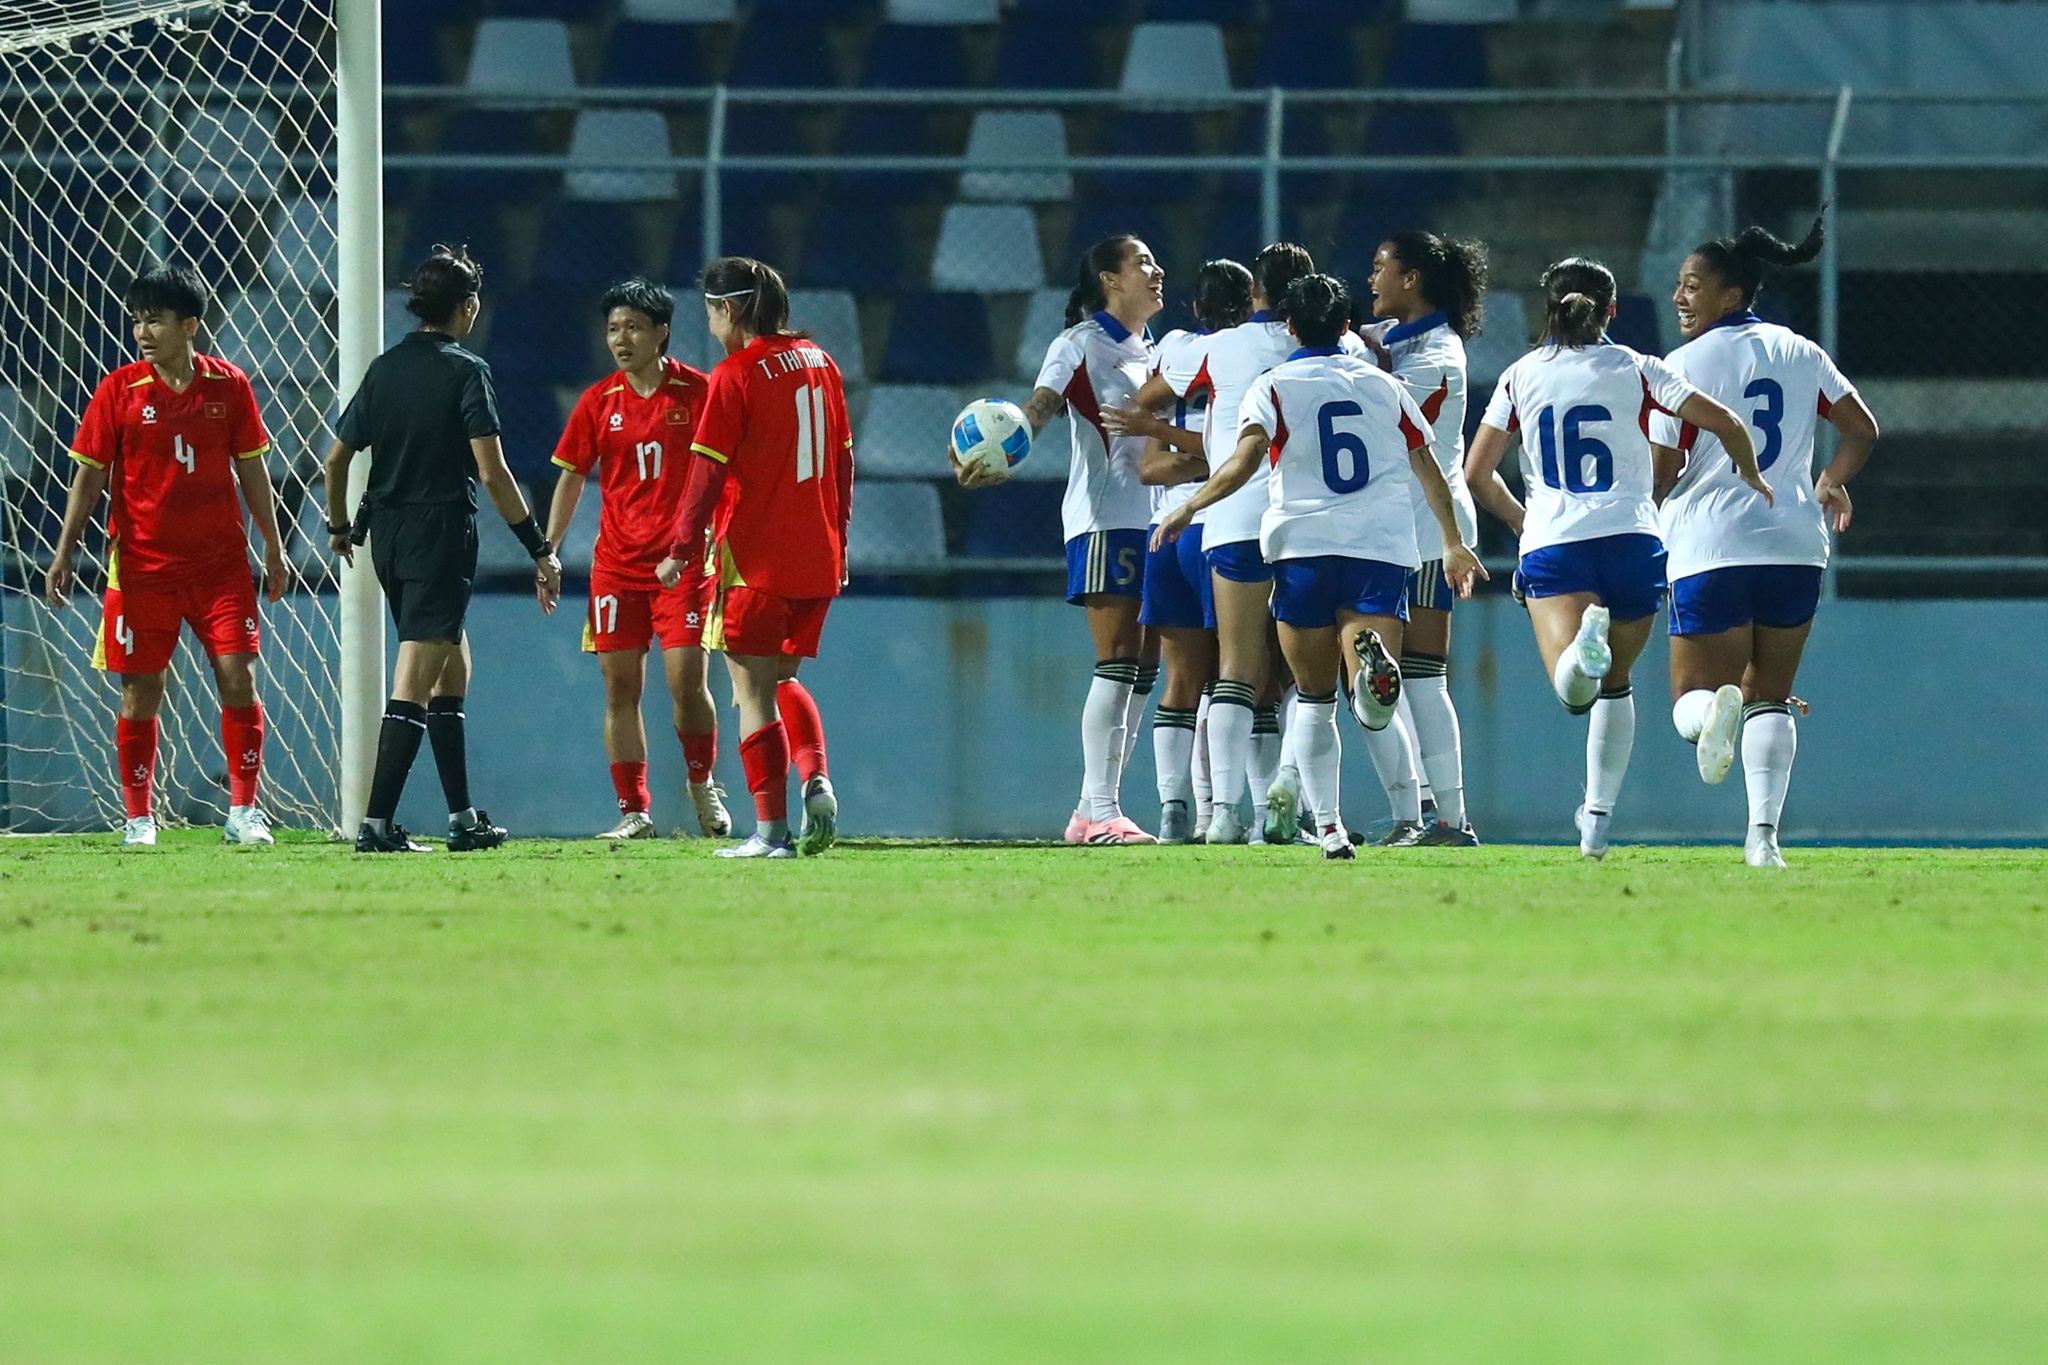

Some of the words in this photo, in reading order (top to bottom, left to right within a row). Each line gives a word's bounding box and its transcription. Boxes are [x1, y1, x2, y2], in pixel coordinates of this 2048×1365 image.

[773, 349, 804, 373] THI
[174, 433, 195, 474] 4
[795, 383, 826, 484] 11
[1317, 400, 1370, 494] 6
[1538, 404, 1614, 494] 16
[635, 440, 663, 481] 17
[115, 614, 134, 656] 4
[594, 594, 618, 635] 17
